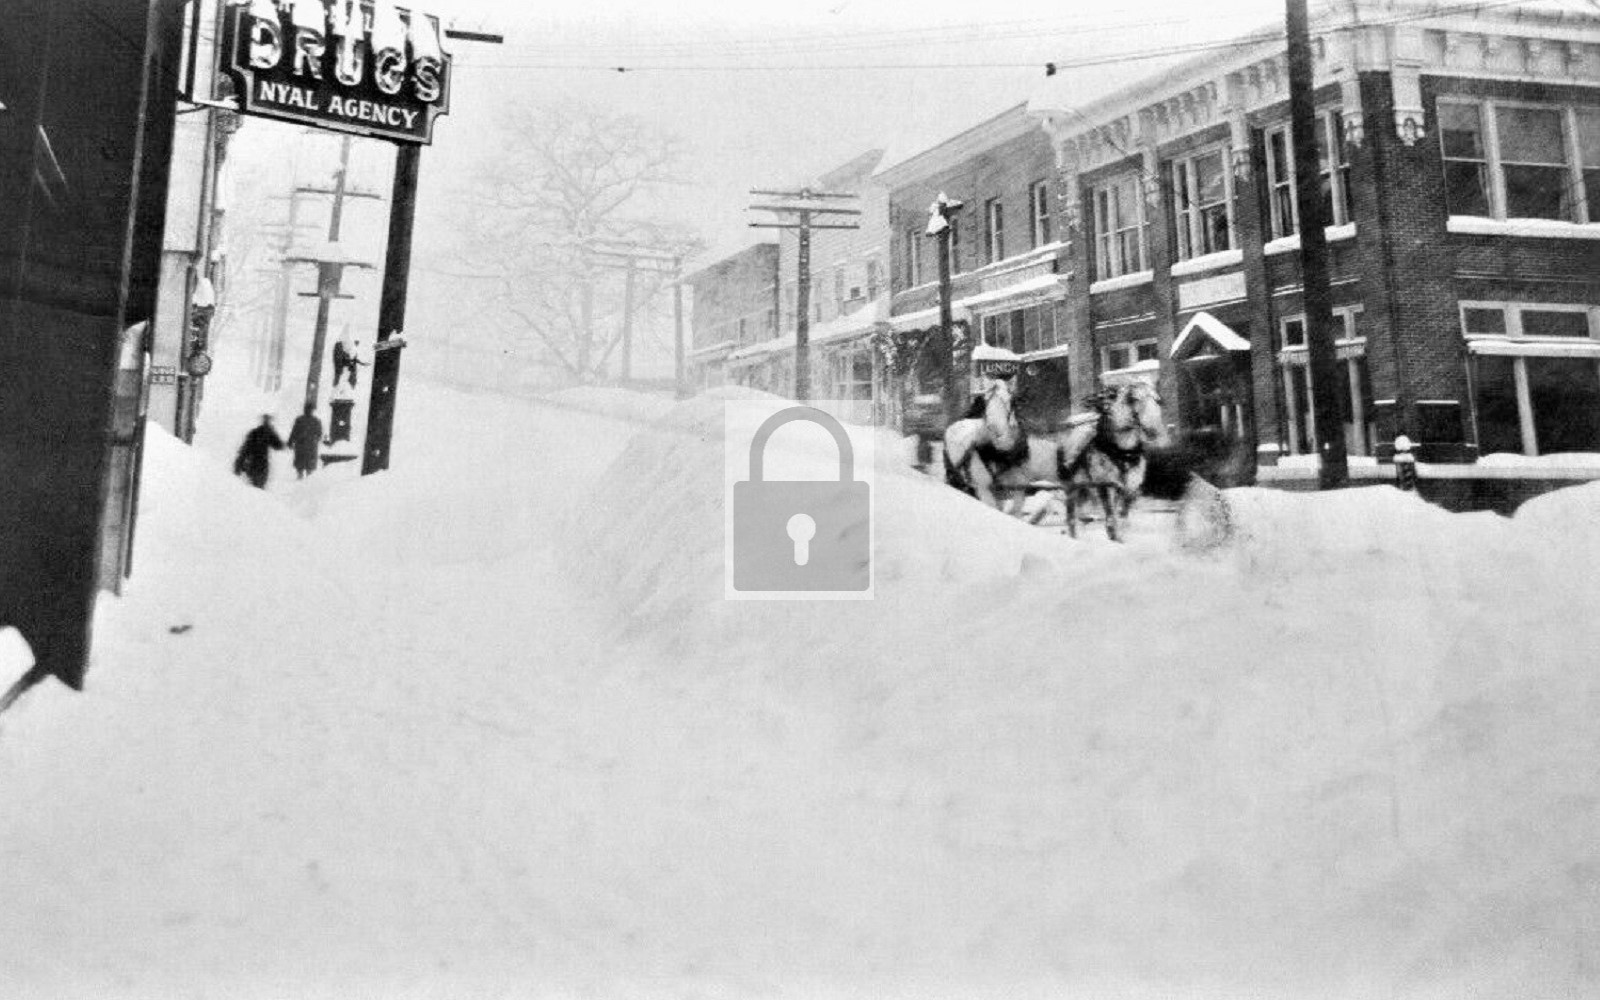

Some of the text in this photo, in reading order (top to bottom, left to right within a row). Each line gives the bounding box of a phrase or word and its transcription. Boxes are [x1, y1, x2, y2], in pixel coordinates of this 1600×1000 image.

[249, 18, 441, 102] DRUGS
[260, 81, 420, 129] NYAL AGENCY
[980, 362, 1019, 375] LUNCH
